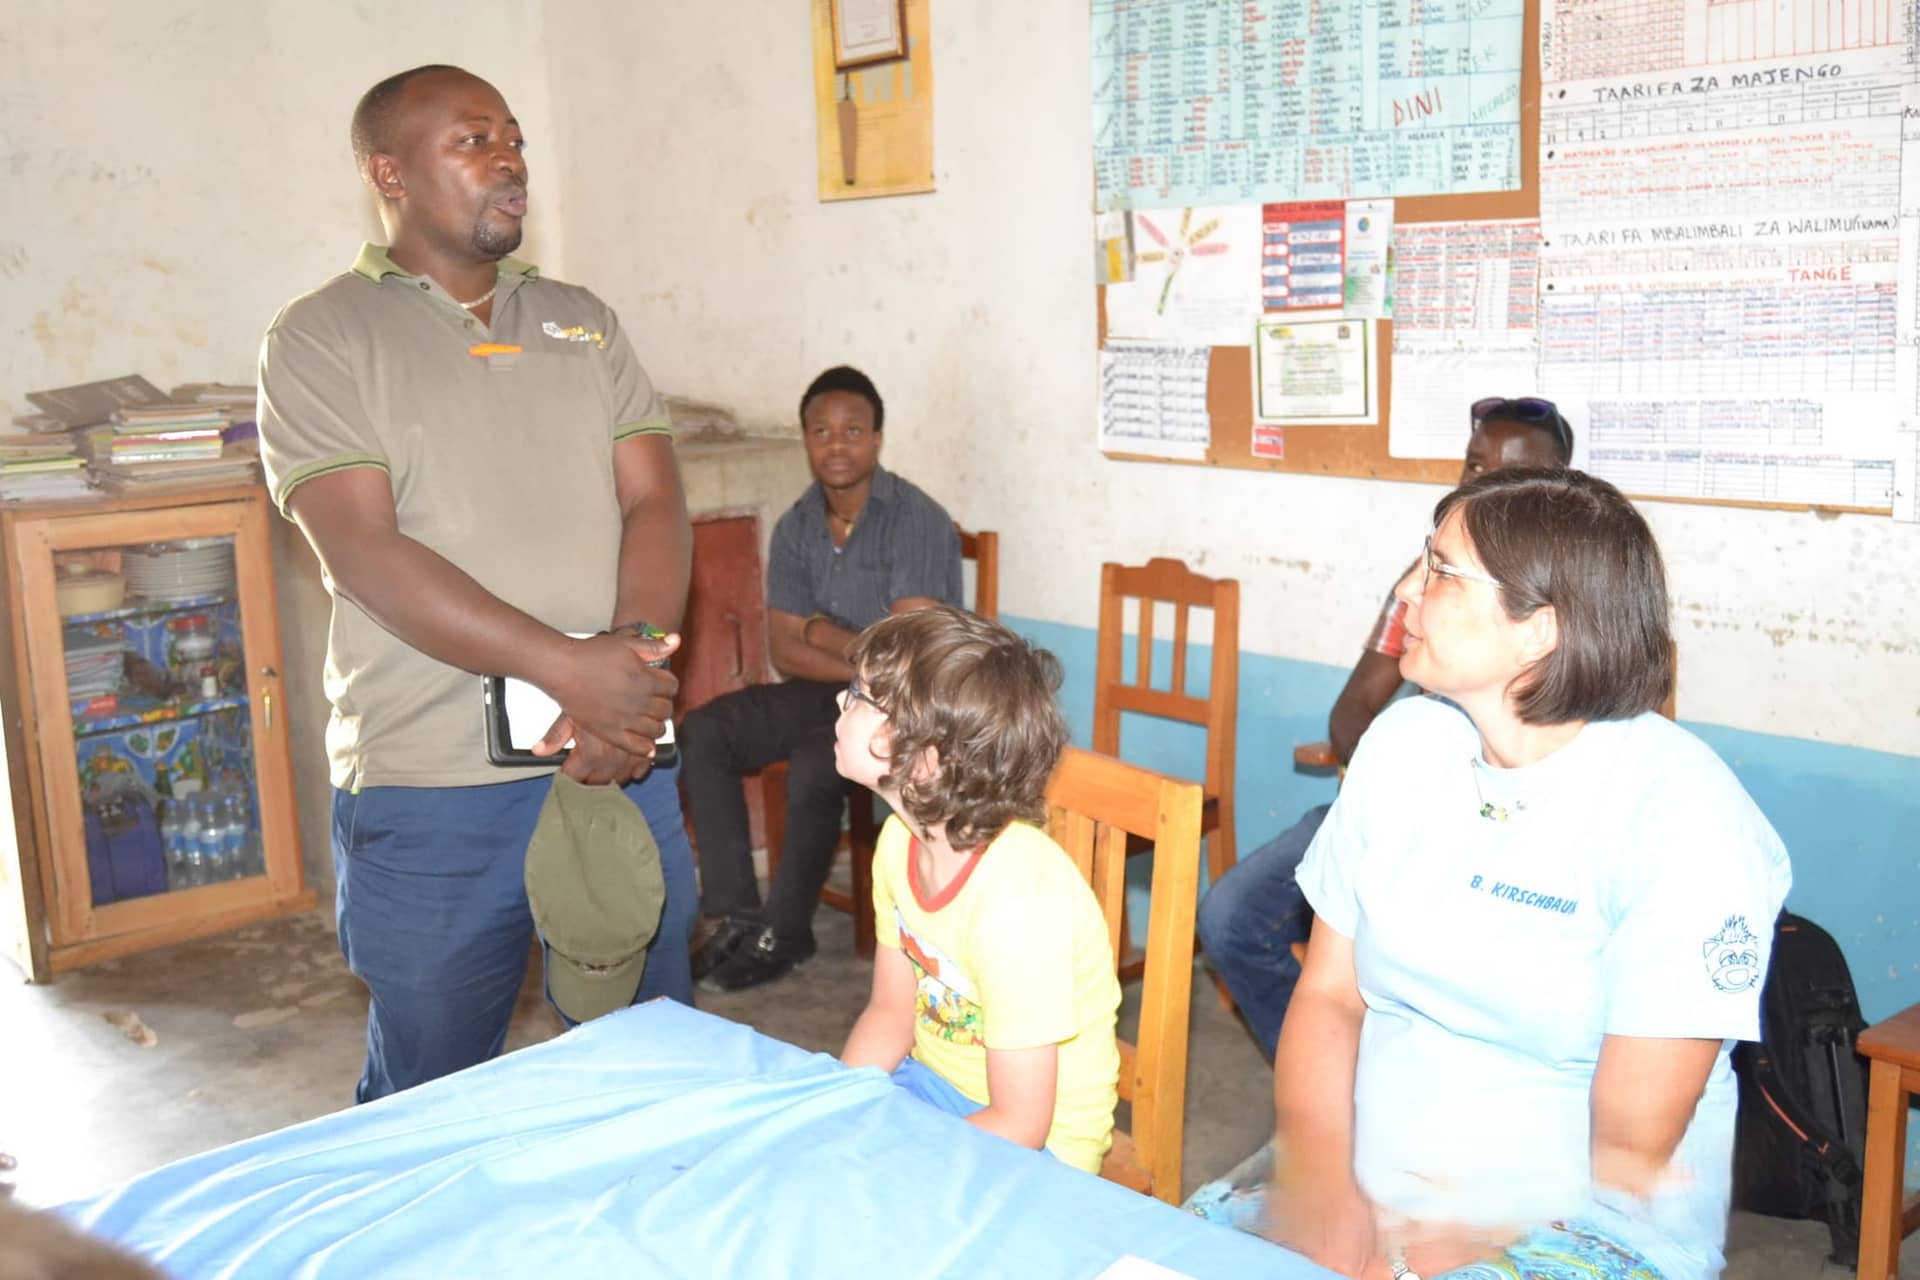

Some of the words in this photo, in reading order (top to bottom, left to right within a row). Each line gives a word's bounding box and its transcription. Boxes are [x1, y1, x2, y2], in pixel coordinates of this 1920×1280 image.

[1690, 76, 1719, 94] ZA
[1731, 64, 1842, 88] MAJENGO
[1392, 85, 1443, 127] DINI
[1754, 220, 1782, 238] ZA
[1787, 266, 1853, 284] TANGE
